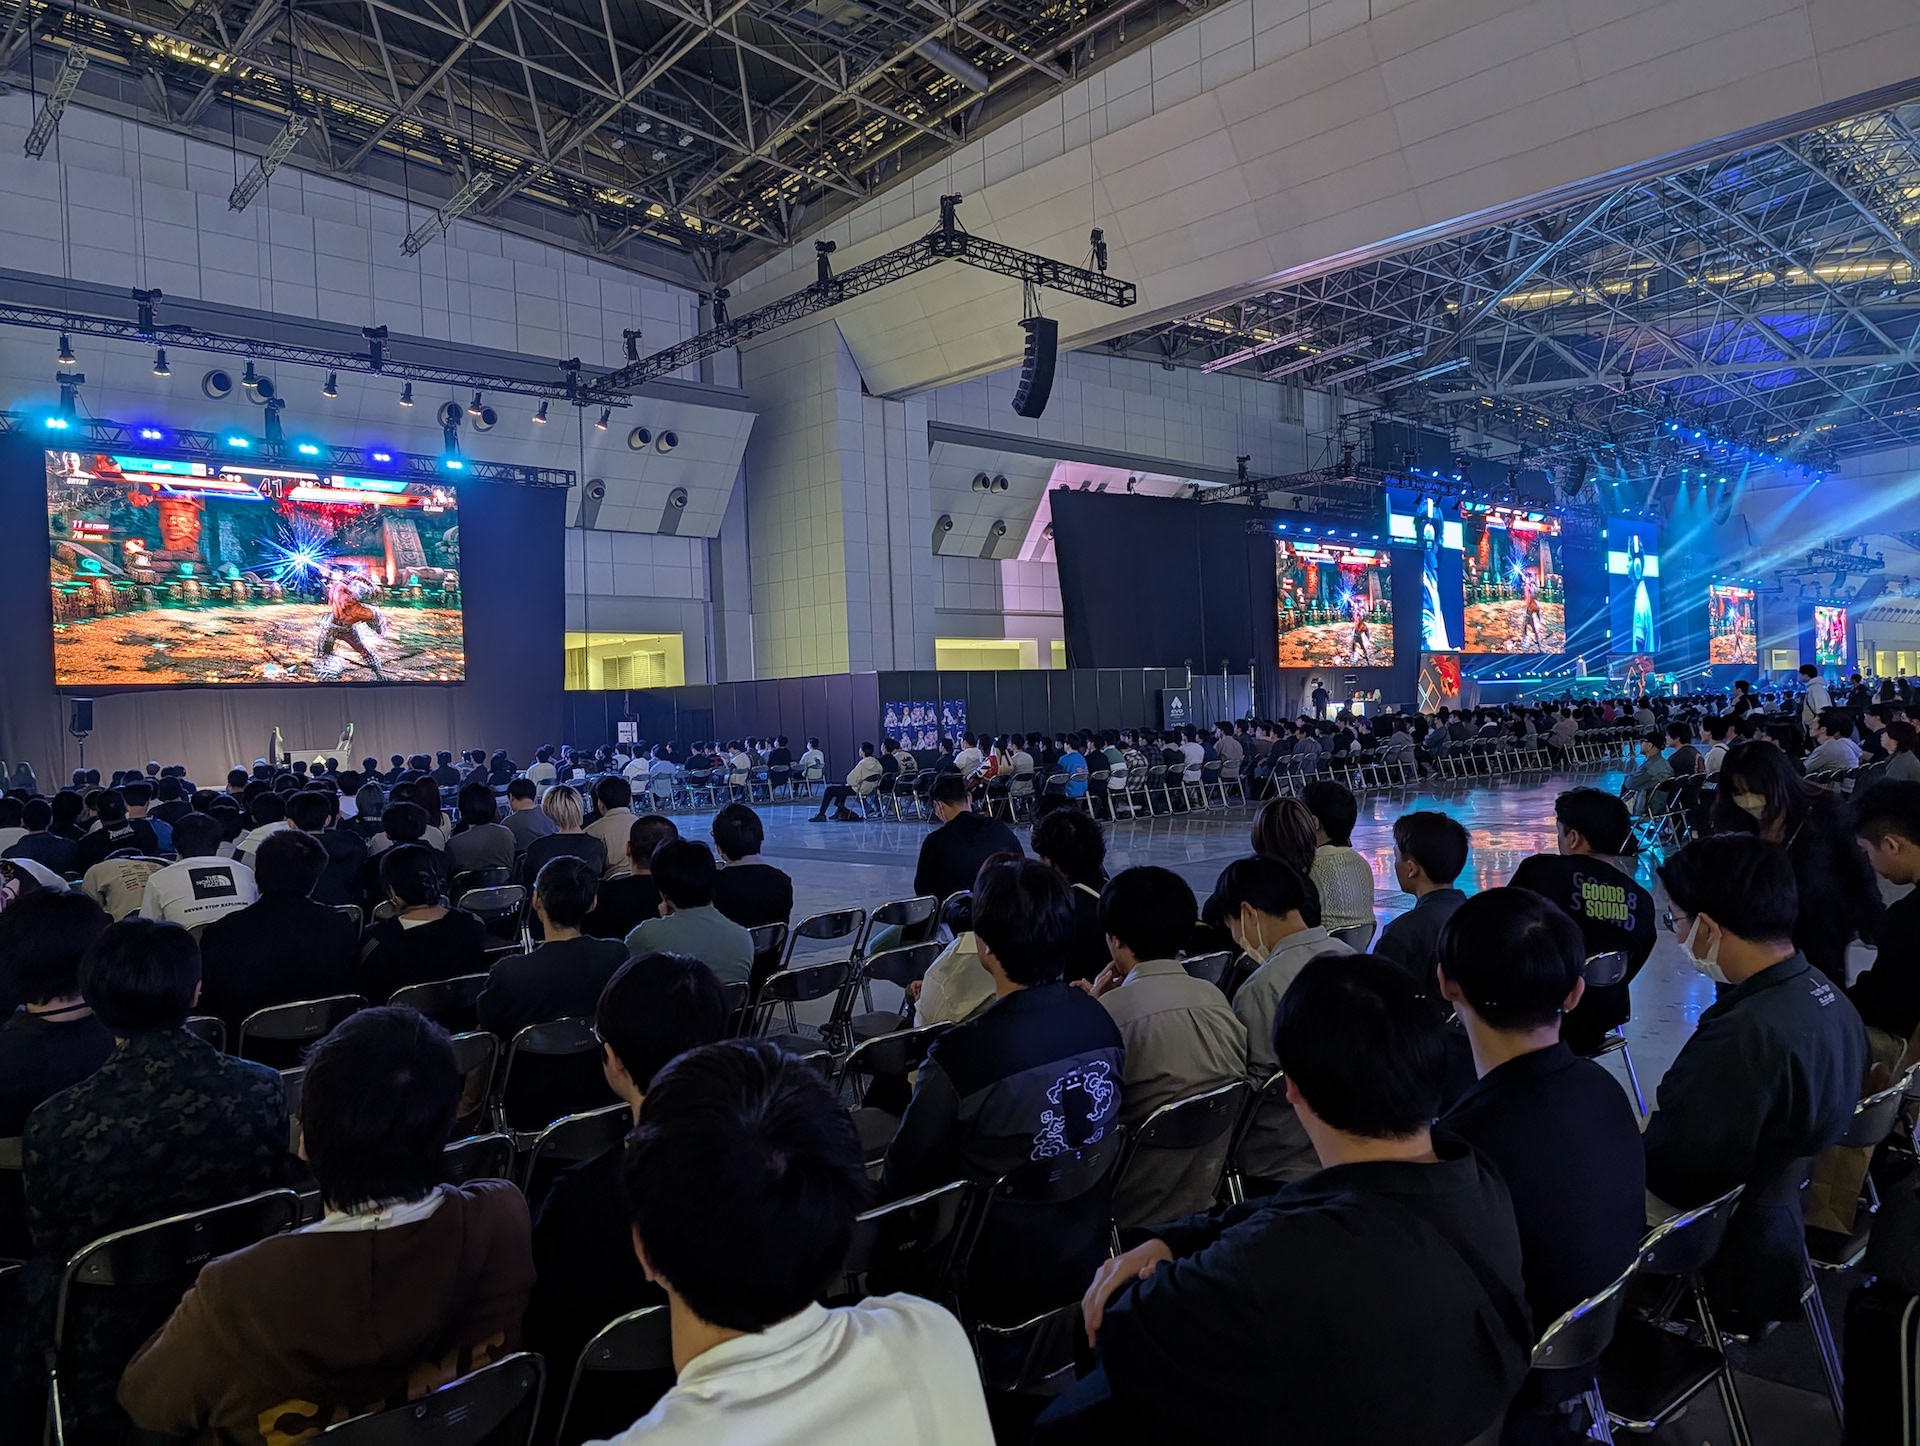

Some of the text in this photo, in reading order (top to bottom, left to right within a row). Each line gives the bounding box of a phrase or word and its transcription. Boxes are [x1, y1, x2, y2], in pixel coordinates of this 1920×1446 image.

[208, 467, 215, 475] 2
[66, 477, 89, 486] BRYAN
[258, 478, 283, 498] 41
[72, 519, 83, 528] 11
[72, 530, 84, 539] 76
[1582, 882, 1626, 903] GOOD8
[1586, 900, 1629, 921] SQUAD
